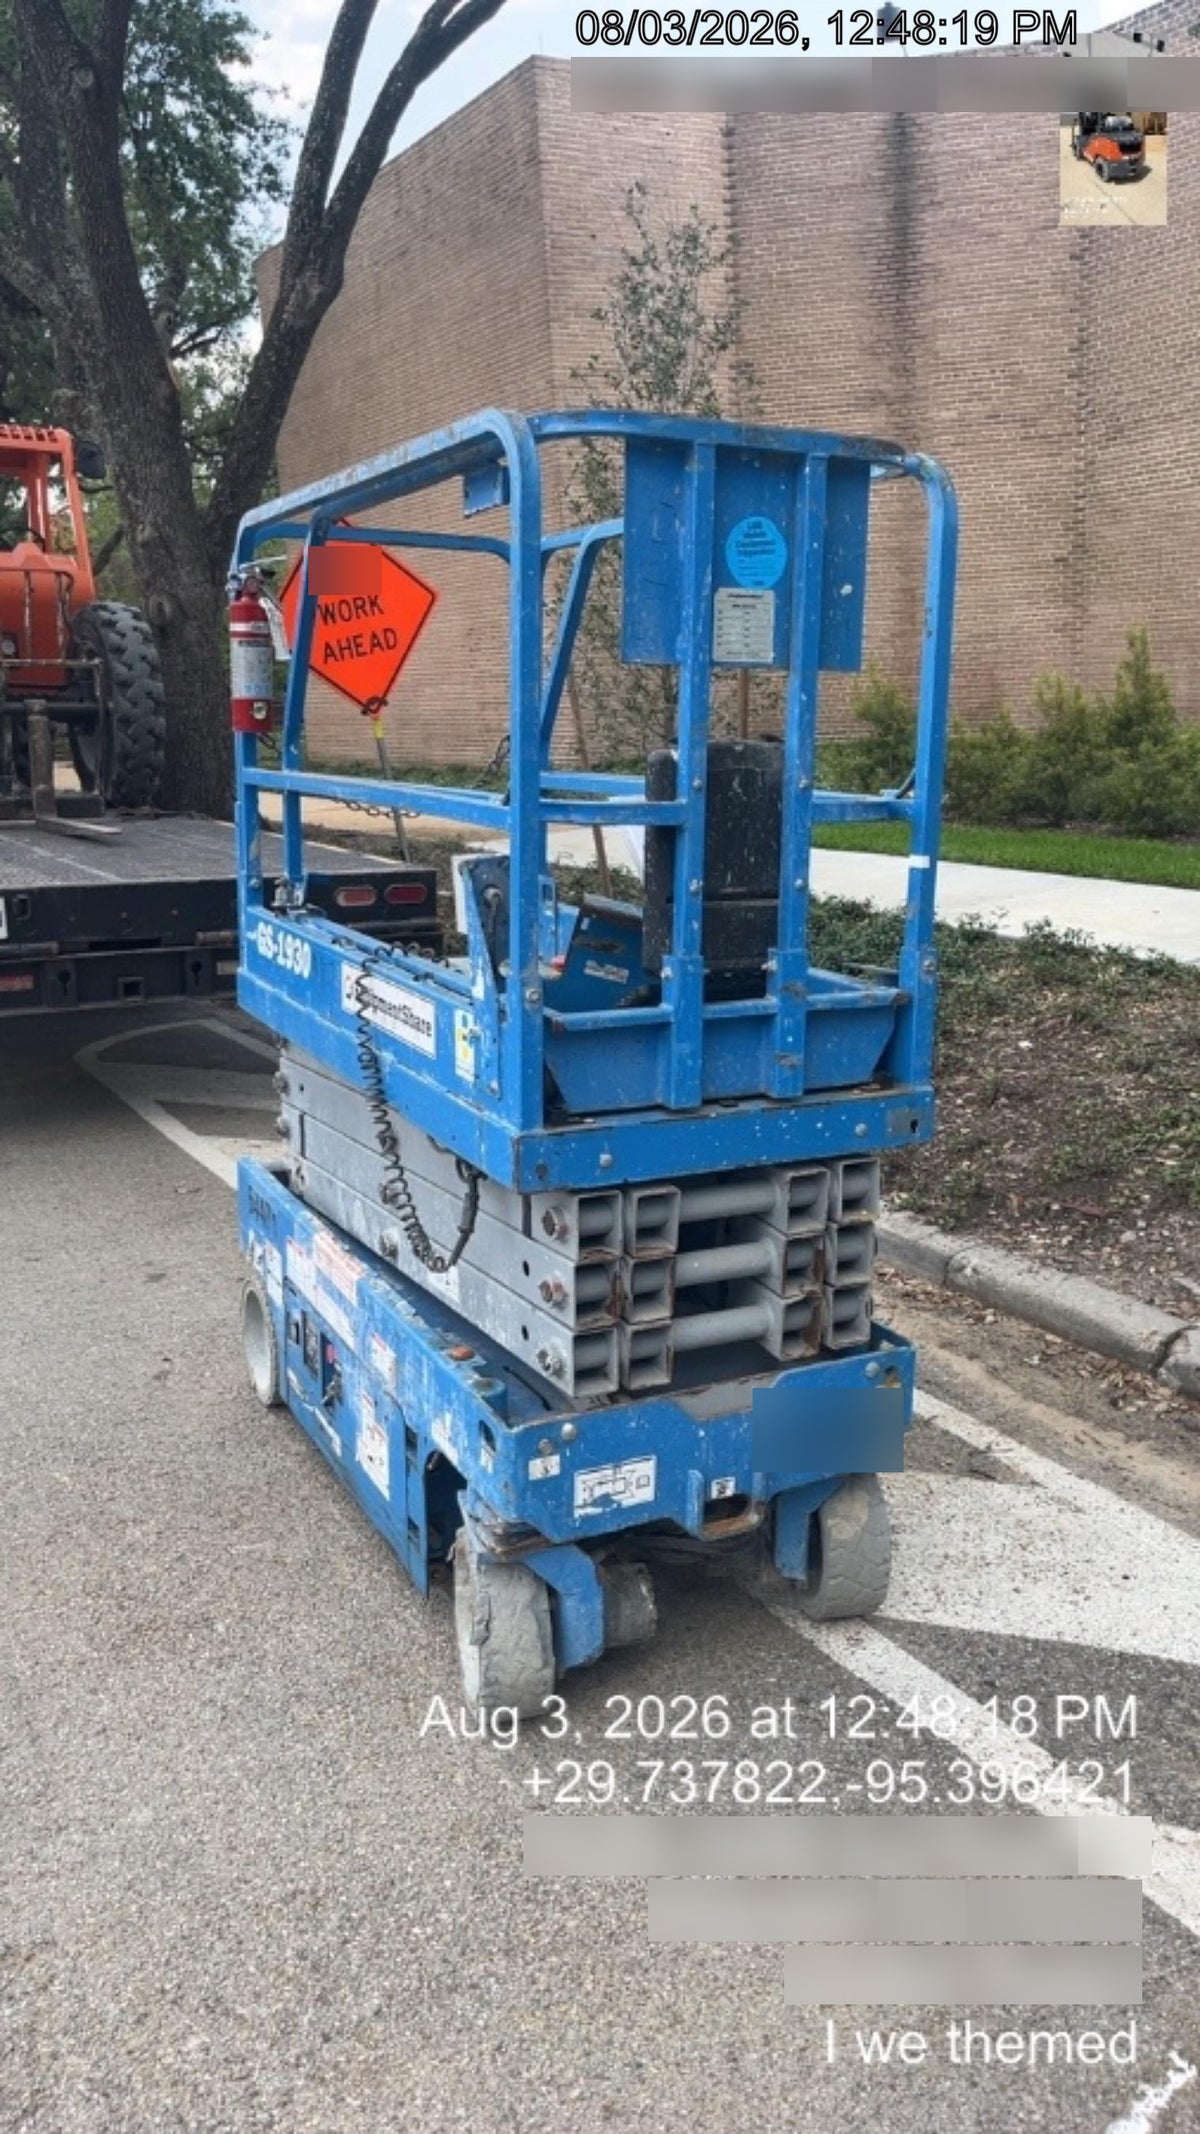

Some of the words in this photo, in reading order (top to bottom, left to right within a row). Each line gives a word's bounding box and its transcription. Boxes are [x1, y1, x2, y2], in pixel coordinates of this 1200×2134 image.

[317, 595, 385, 626] WORK
[323, 627, 398, 665] AHEAD
[256, 920, 312, 979] GS-1930
[355, 984, 432, 1037] uipmentShare
